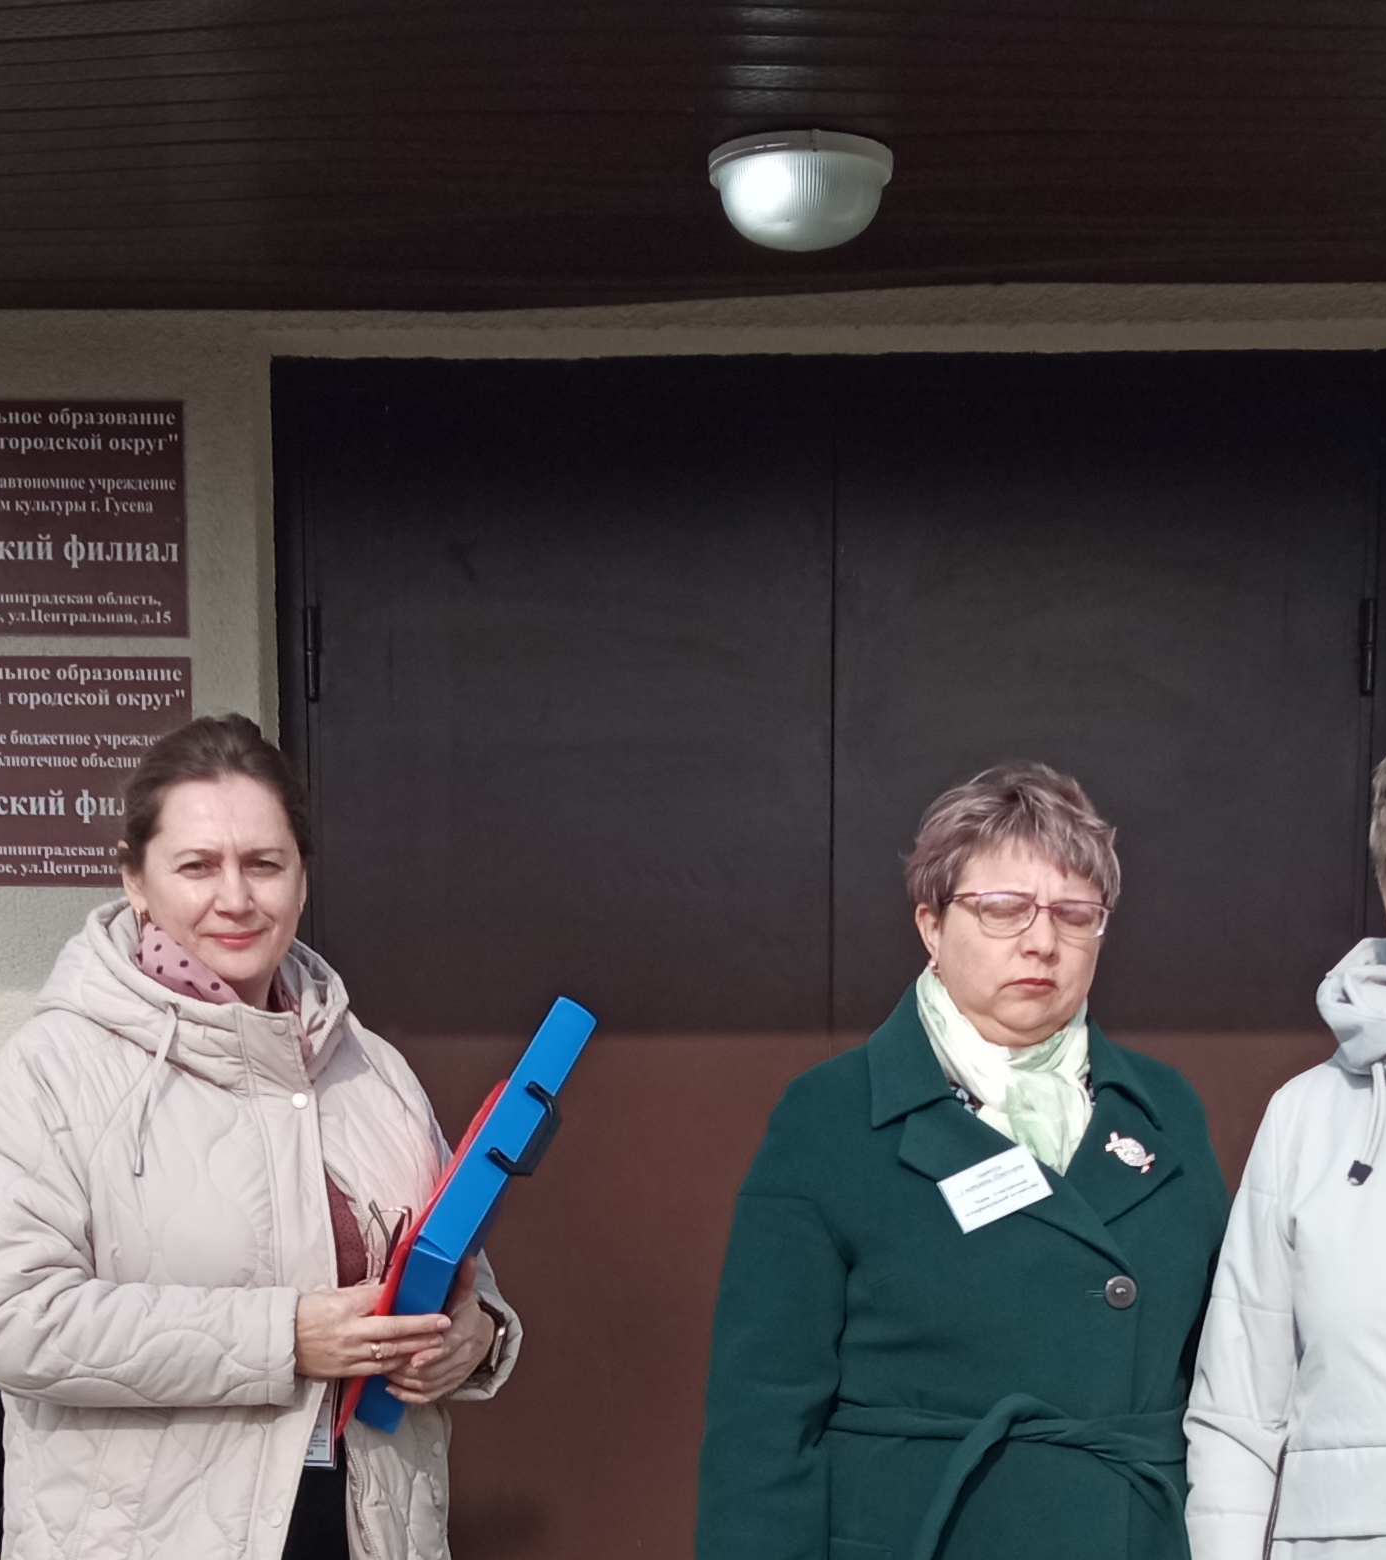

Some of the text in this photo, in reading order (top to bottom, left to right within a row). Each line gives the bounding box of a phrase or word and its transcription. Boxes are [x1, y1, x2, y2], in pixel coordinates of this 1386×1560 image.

[48, 408, 175, 429] образование
[0, 432, 102, 454] городской
[108, 433, 179, 455] округ"
[0, 477, 85, 490] автономное
[89, 478, 176, 494] учреждение
[15, 499, 86, 516] культуры
[90, 500, 101, 513] г.
[104, 497, 154, 516] Гусева
[63, 534, 179, 569] филиал
[97, 592, 162, 607] область,
[140, 611, 172, 626] д.15
[56, 664, 182, 685] образование
[8, 688, 110, 710] городской
[116, 689, 186, 710] округ"
[10, 730, 91, 746] бюджетное
[94, 733, 165, 749] учрежде
[81, 753, 141, 769] объедин
